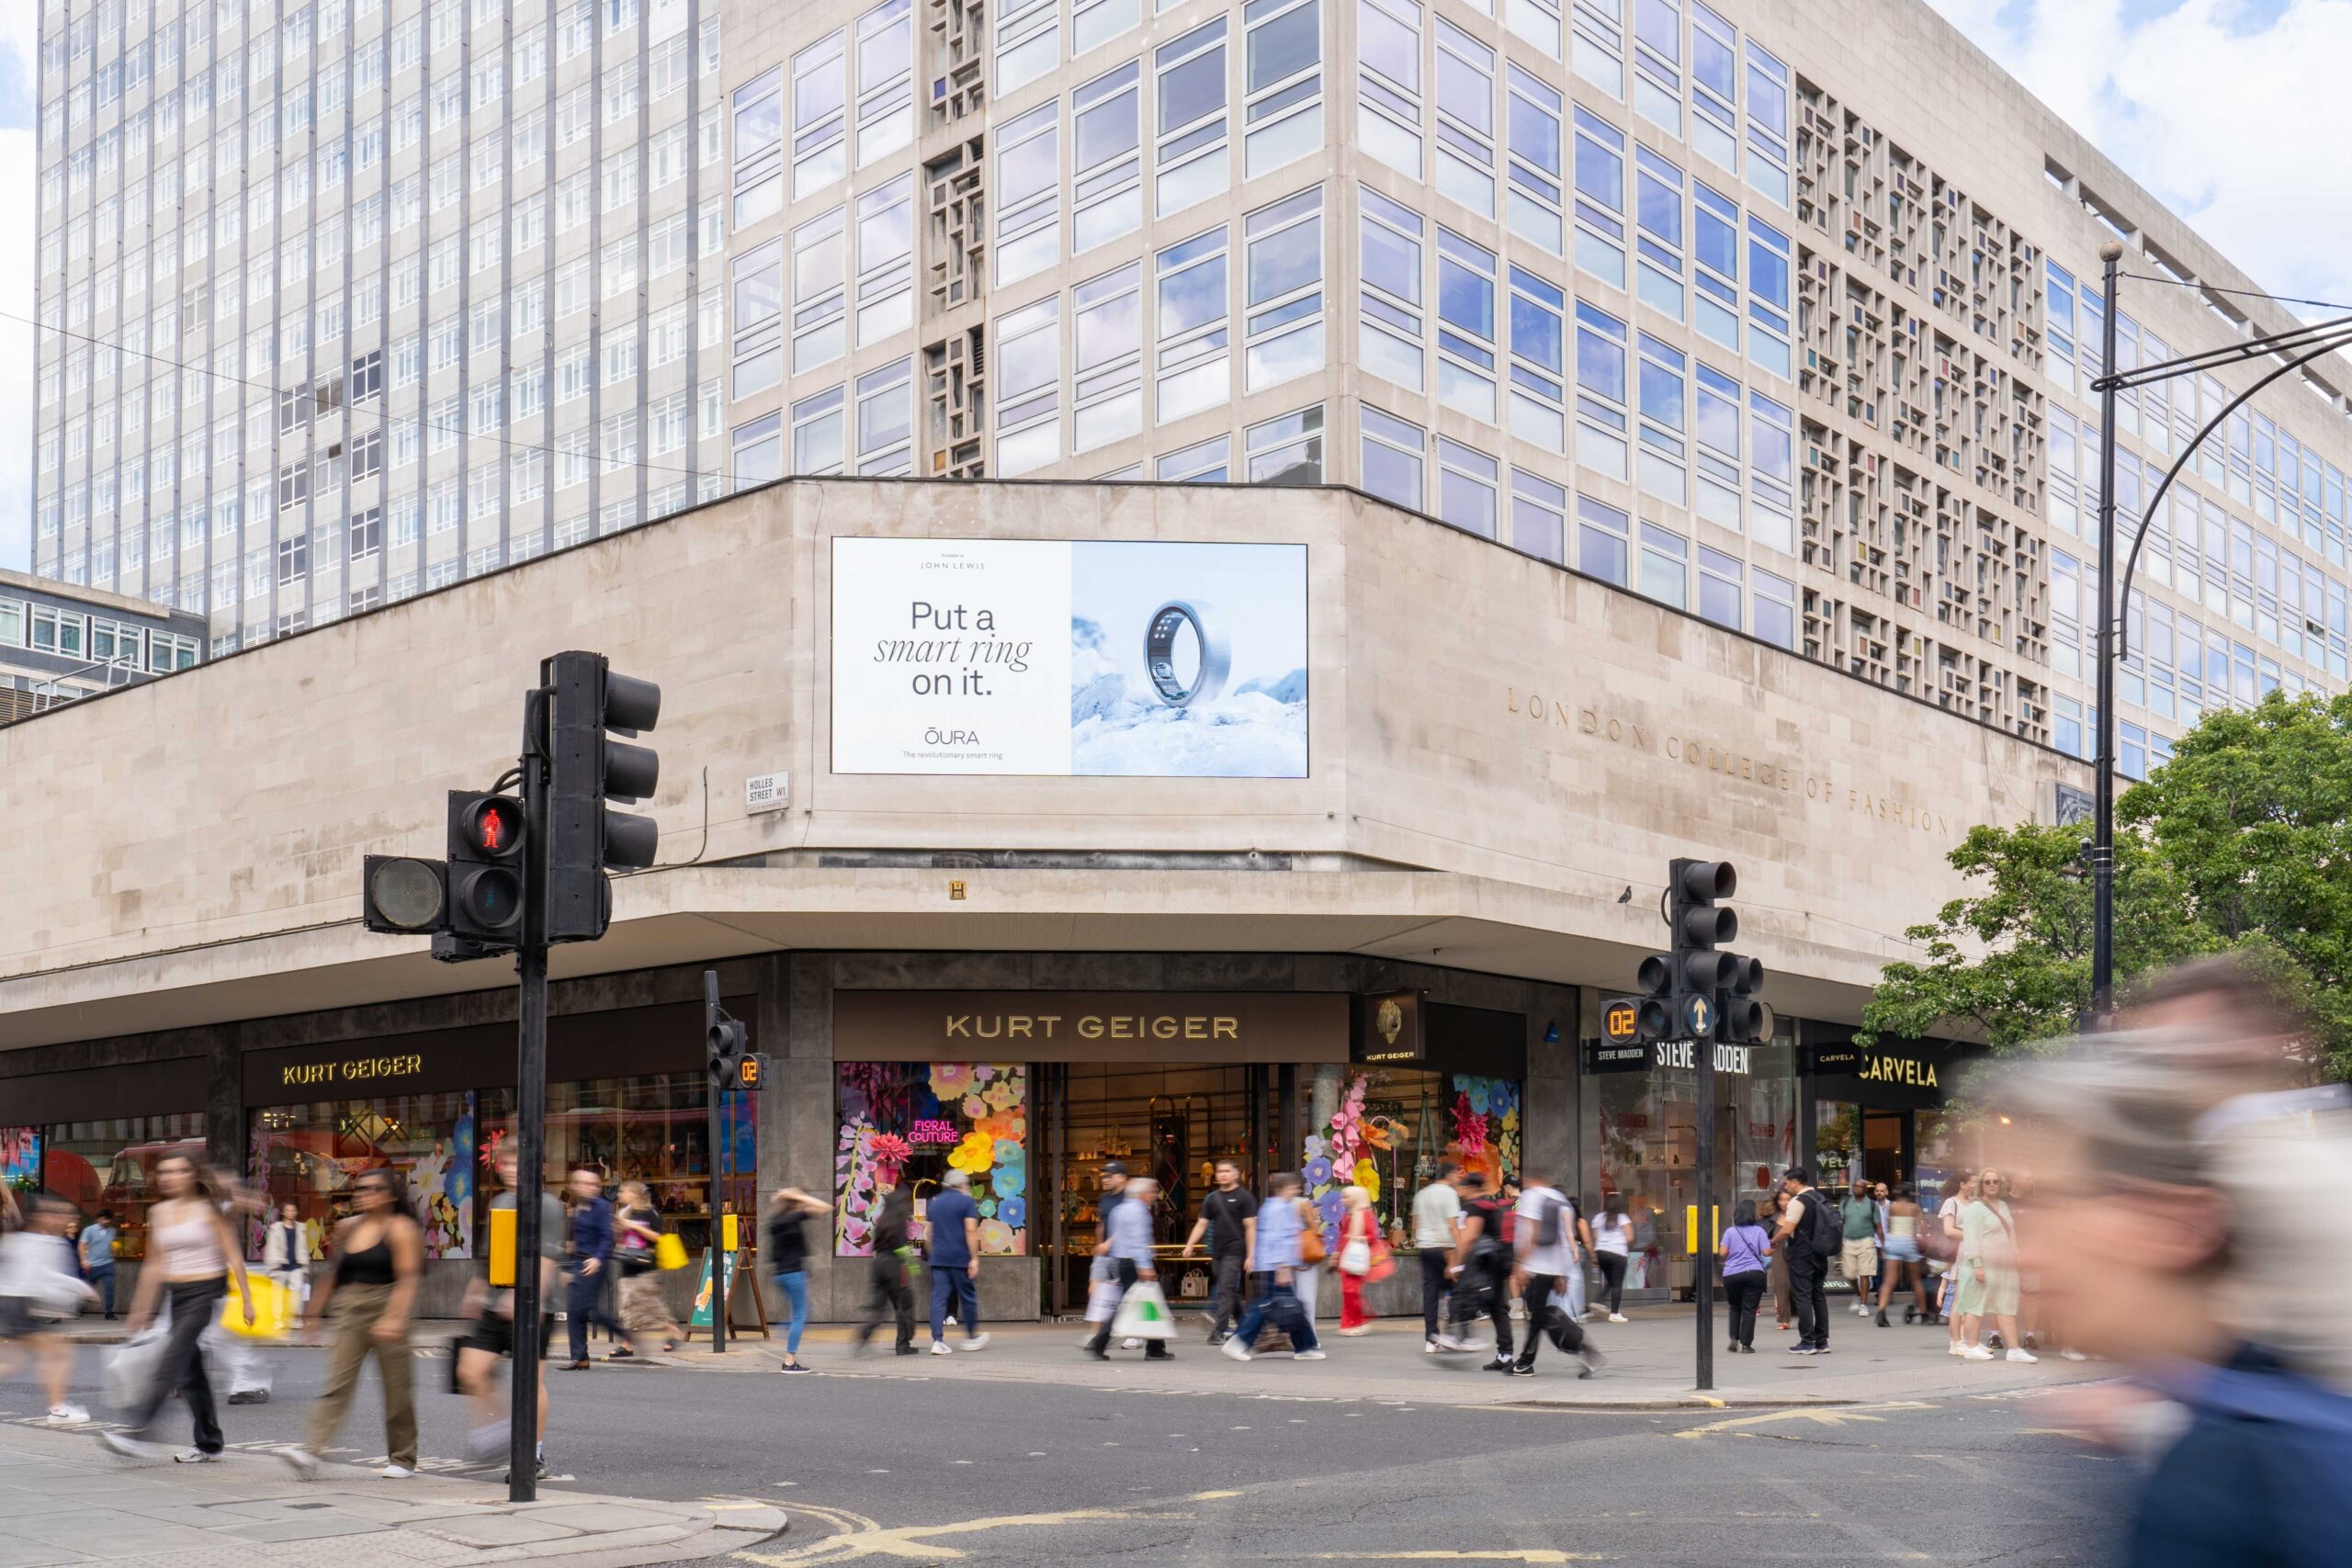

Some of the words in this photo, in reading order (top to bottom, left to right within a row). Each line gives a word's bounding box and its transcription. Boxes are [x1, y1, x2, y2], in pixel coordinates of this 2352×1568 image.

[953, 562, 985, 570] LEWIS
[911, 602, 967, 630] Put
[976, 610, 995, 630] a
[874, 637, 963, 663] smart
[969, 633, 1034, 672] ring
[912, 673, 952, 695] on
[963, 667, 992, 695] it.
[918, 751, 965, 761] revolutionary
[989, 751, 1003, 761] ring
[1506, 687, 1647, 749] LONDON
[1666, 737, 1790, 791] COLLEGE
[1806, 777, 1833, 804] OF
[1849, 789, 1949, 837] FASHION
[750, 777, 774, 791] HOLLES
[750, 789, 773, 802] STREET
[776, 787, 786, 797] W1
[952, 883, 964, 898] H
[946, 1015, 1062, 1038] KURT
[1077, 1015, 1239, 1039] GEIGER
[1610, 1010, 1634, 1035] 02
[1387, 1051, 1415, 1059] GEIGER
[1598, 1050, 1617, 1060] STEVE
[1617, 1048, 1644, 1059] MADDEN
[1657, 1041, 1695, 1068] STEVE
[1819, 1054, 1855, 1063] CARVELA
[283, 1062, 337, 1085] KURT
[343, 1054, 422, 1080] GEIGER
[742, 1061, 758, 1081] 02
[914, 1120, 955, 1131] FLORAL
[908, 1131, 959, 1143] COUTURE
